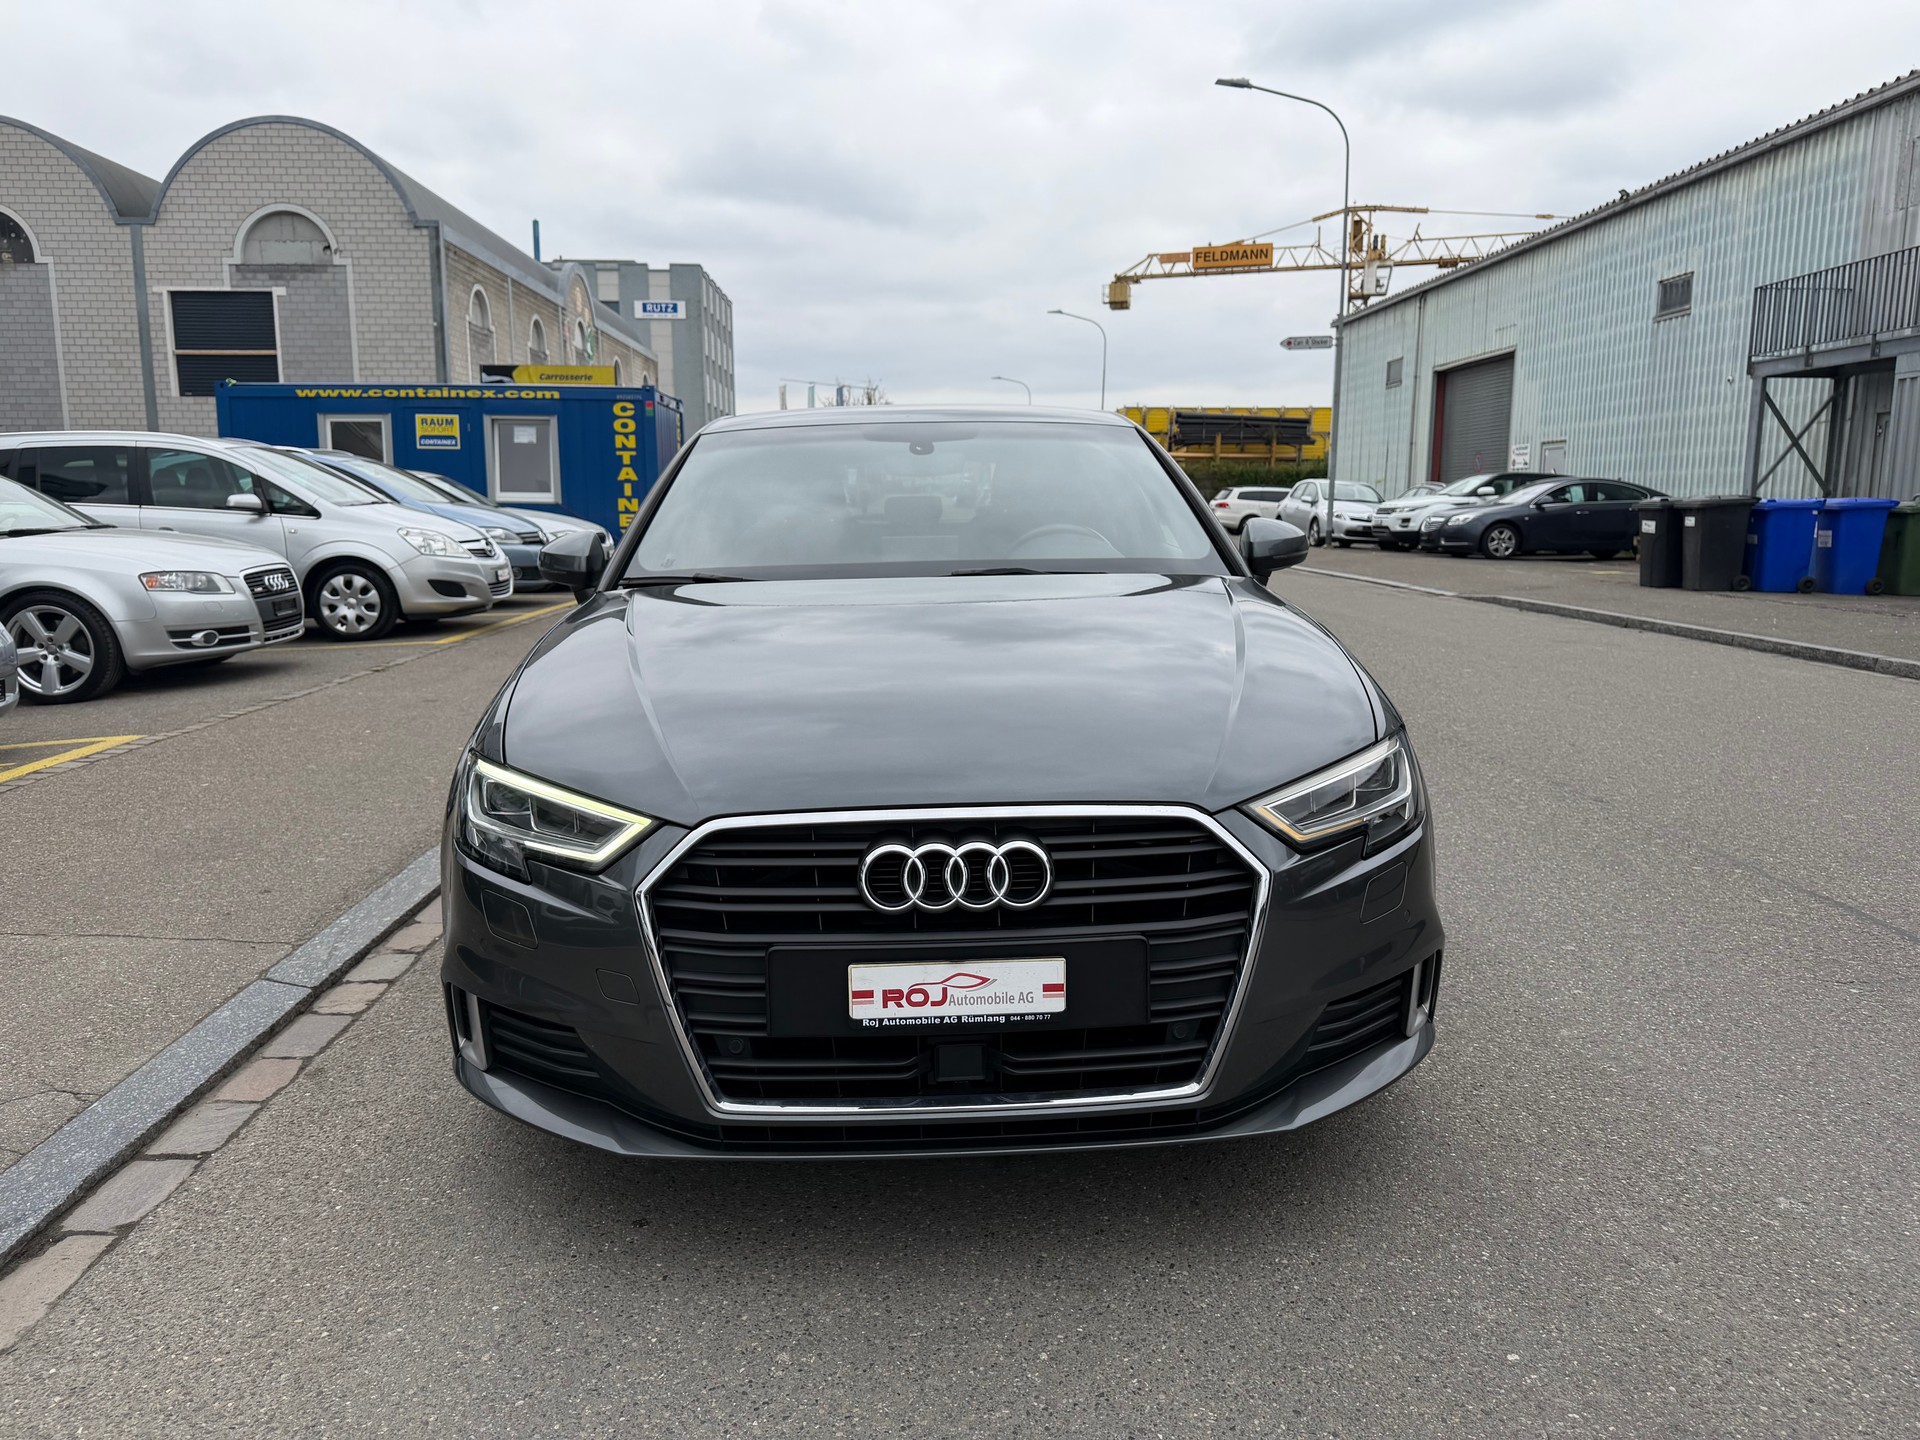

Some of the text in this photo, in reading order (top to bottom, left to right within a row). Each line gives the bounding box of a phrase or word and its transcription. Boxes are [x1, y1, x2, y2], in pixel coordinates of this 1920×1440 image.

[1195, 248, 1269, 263] FELDMANN
[645, 303, 675, 313] RUTZ
[539, 372, 593, 381] Carrosserie
[295, 387, 560, 399] www.containex.com
[420, 417, 455, 427] RAUM
[420, 438, 457, 446] CONTAINEX
[612, 401, 639, 535] CONTAINE
[882, 986, 1034, 1009] ROJ Automobile AG
[862, 1018, 879, 1028] Roj
[882, 1016, 941, 1027] Automobile
[943, 1015, 958, 1025] AG
[961, 1014, 1006, 1024] Rümlang
